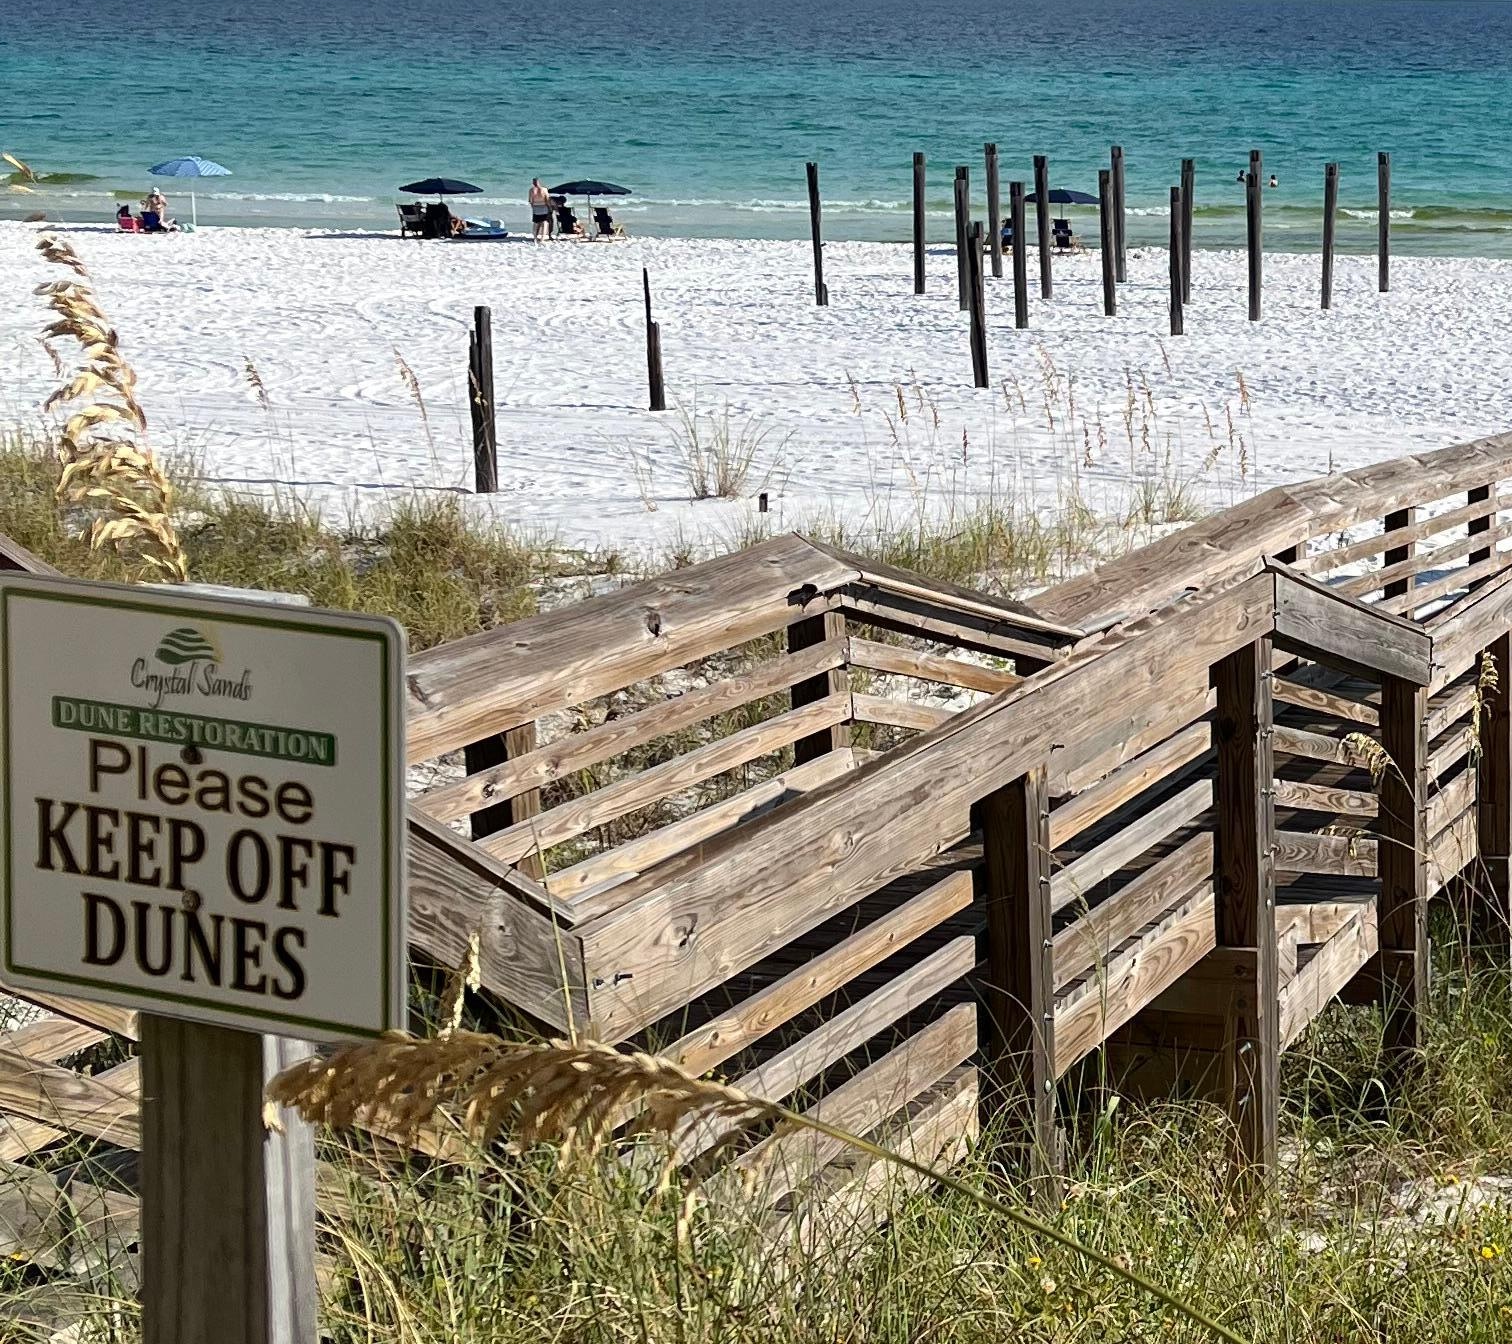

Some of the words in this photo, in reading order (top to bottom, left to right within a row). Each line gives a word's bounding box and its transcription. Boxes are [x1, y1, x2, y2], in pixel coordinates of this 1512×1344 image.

[130, 657, 195, 709] Crystal
[196, 663, 254, 702] Sands
[58, 701, 132, 733] DUNE
[138, 708, 329, 762] RESTORATION
[88, 737, 314, 825] Please
[34, 797, 206, 892] KEEP
[226, 828, 357, 918] OFF
[81, 891, 307, 1001] DUNES
